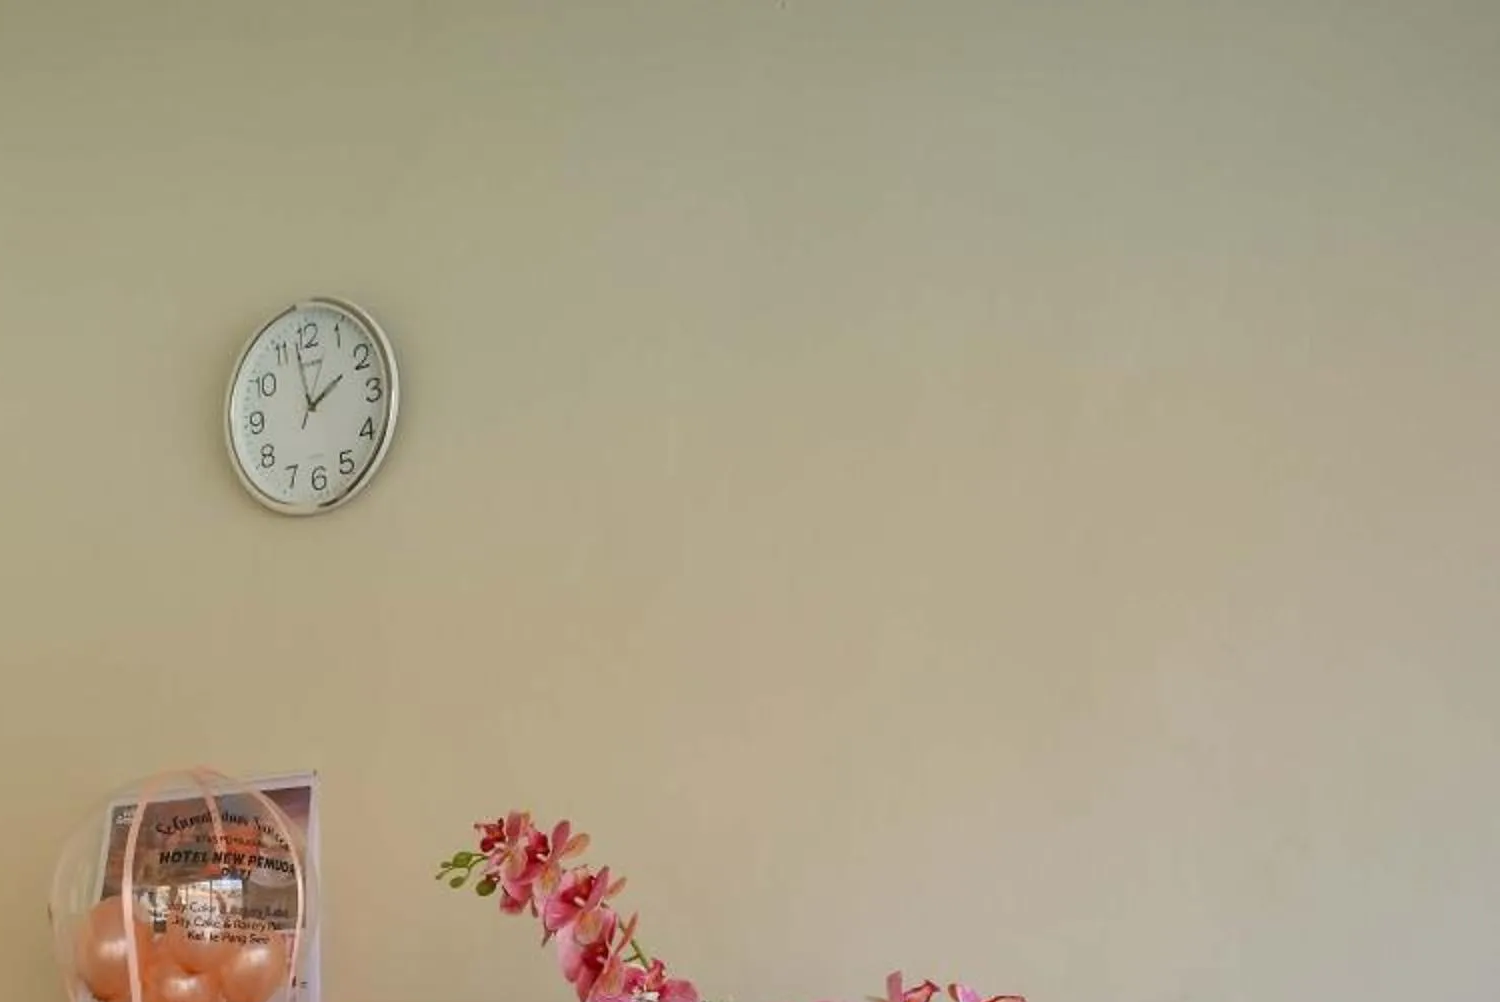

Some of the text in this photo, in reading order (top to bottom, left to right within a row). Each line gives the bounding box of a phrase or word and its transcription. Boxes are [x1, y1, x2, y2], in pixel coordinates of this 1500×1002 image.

[297, 323, 318, 349] 12
[334, 323, 341, 348] 1
[276, 341, 289, 366] 11
[353, 344, 370, 370] 2
[250, 372, 277, 398] 10
[365, 377, 382, 403] 3
[250, 411, 265, 435] 9
[359, 416, 375, 440] 4
[260, 444, 275, 468] 8
[339, 450, 355, 475] 5
[285, 464, 299, 489] 7
[311, 466, 327, 491] 6
[159, 849, 209, 864] HOTEL
[211, 850, 247, 865] NEW
